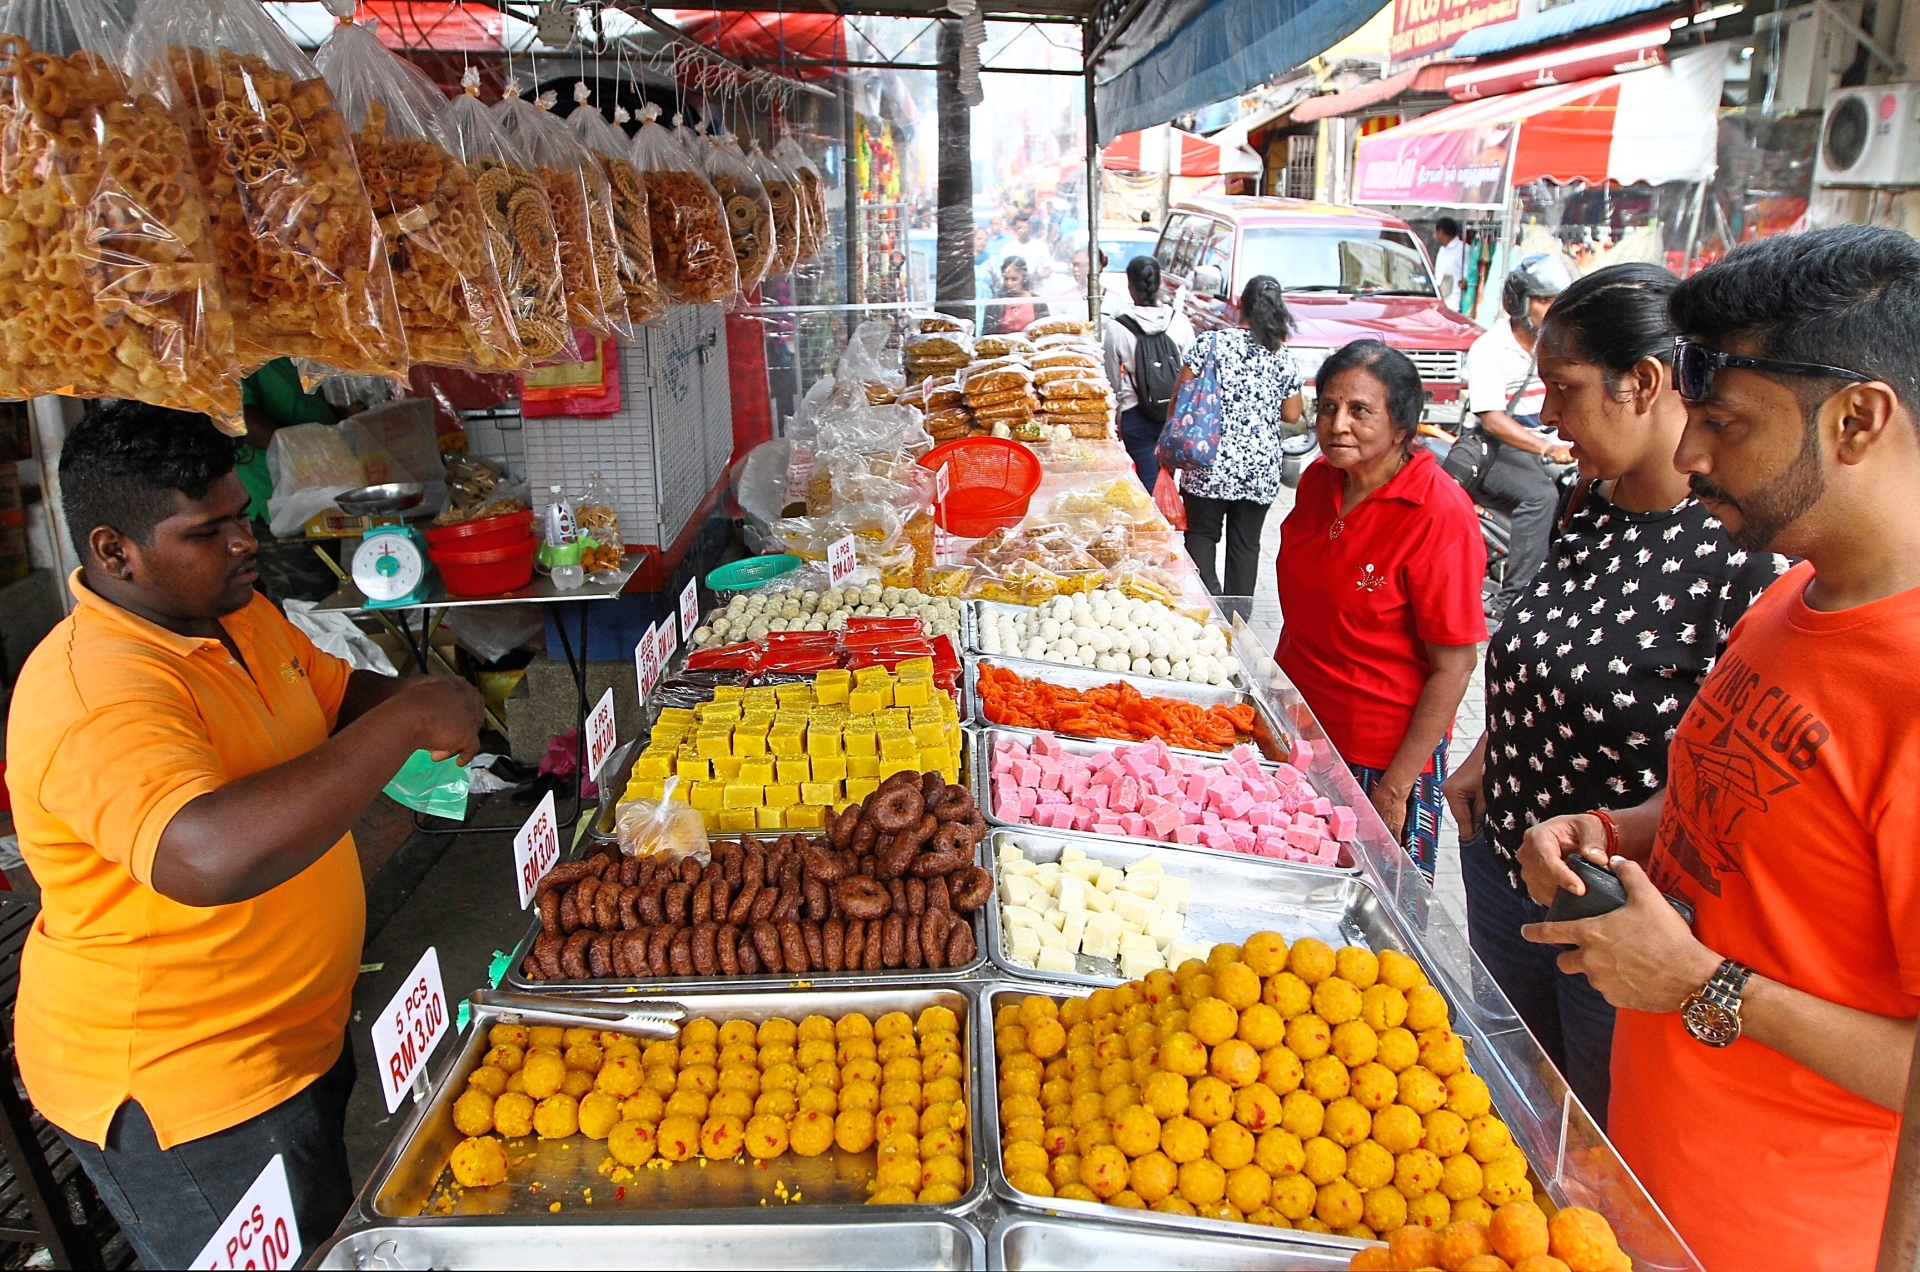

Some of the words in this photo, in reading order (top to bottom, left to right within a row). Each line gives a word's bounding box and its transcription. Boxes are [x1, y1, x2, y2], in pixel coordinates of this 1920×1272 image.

[1413, 20, 1440, 47] VIDEO
[836, 548, 840, 559] 5
[840, 543, 849, 557] PCS
[833, 563, 843, 582] RM
[843, 555, 854, 575] 4.00
[684, 610, 691, 632] RM
[646, 646, 654, 663] PCS
[659, 631, 667, 661] RM
[642, 675, 650, 697] RM
[594, 718, 598, 734] 5
[598, 704, 608, 723] PCS
[1746, 686, 1830, 771] CLUB
[592, 733, 603, 769] RM
[602, 718, 614, 755] 3.00
[527, 833, 532, 851] 5
[533, 812, 548, 842] PCS
[523, 854, 540, 895] RM
[538, 827, 556, 873] 3.00
[395, 1011, 404, 1035] 5
[405, 977, 428, 1021] PCS
[389, 1031, 417, 1094] RM
[415, 992, 442, 1053] 3.00
[226, 1204, 264, 1270] PCS
